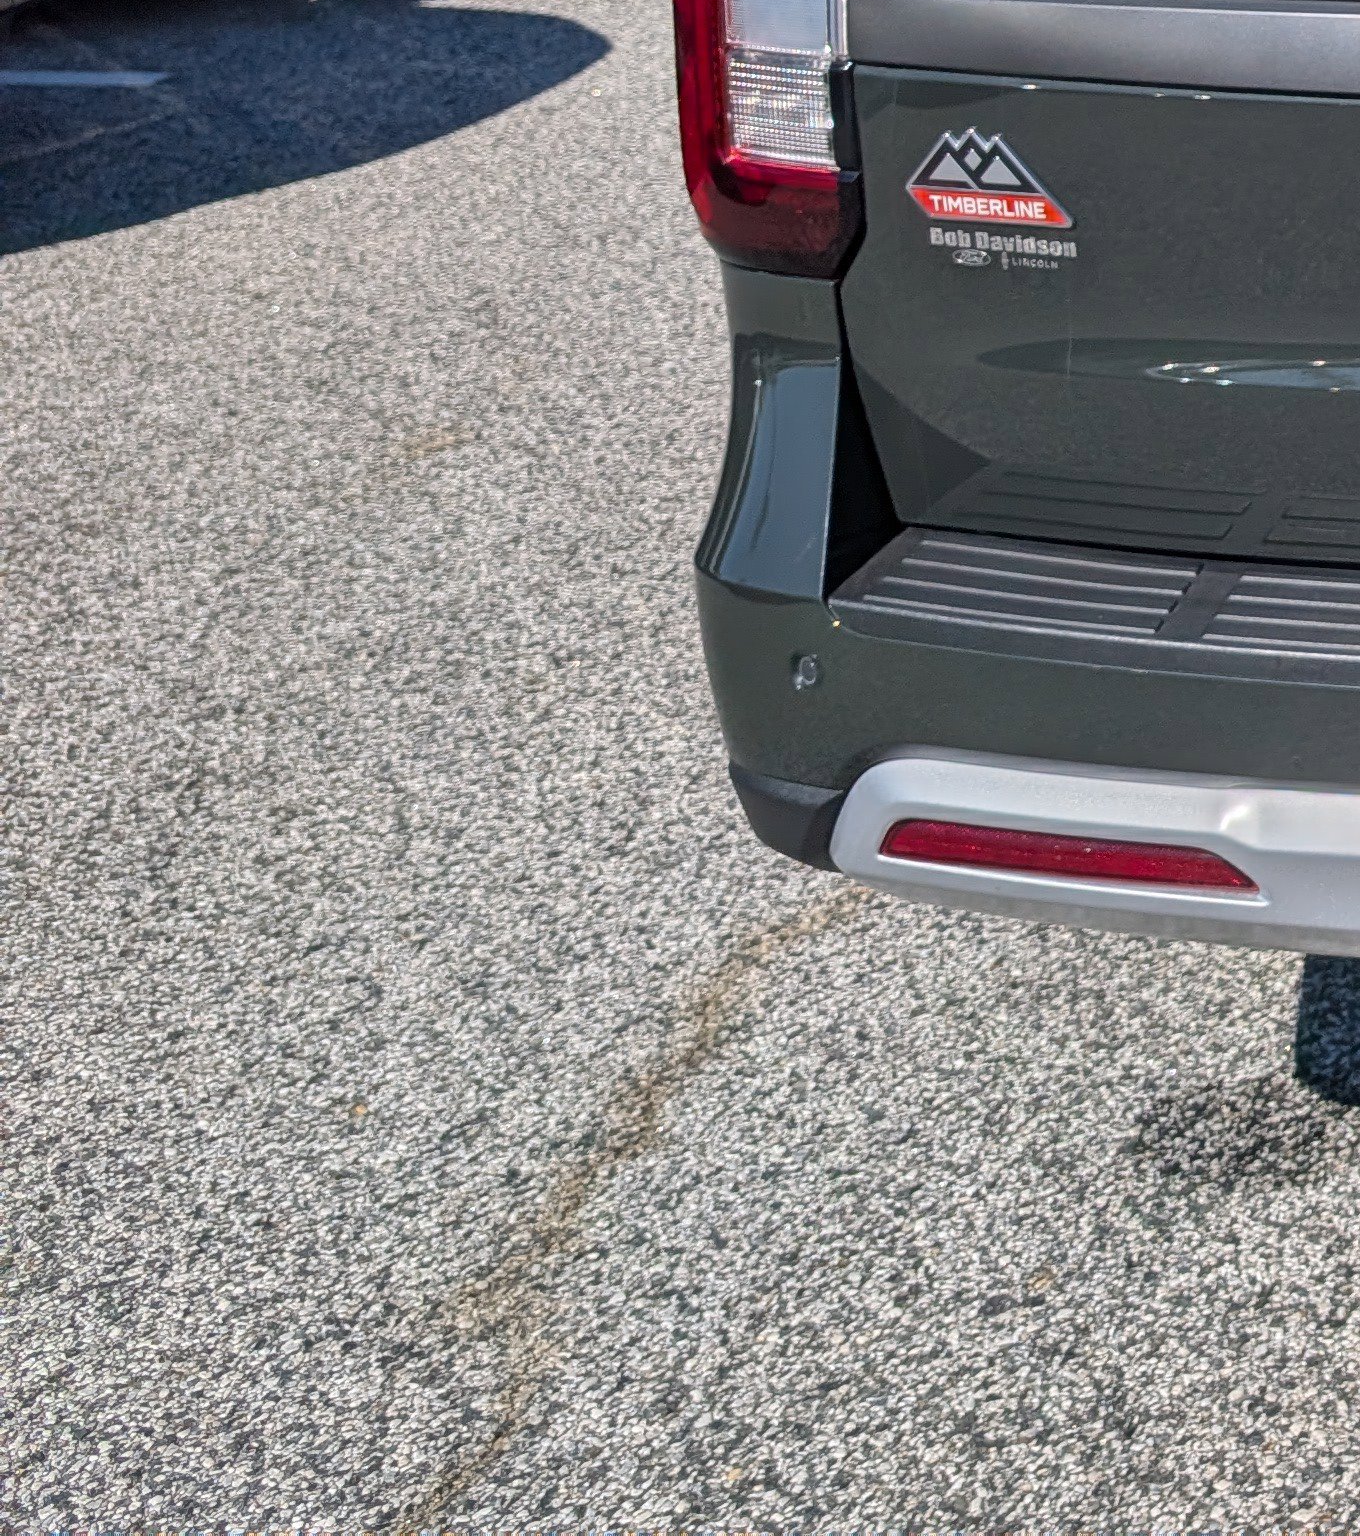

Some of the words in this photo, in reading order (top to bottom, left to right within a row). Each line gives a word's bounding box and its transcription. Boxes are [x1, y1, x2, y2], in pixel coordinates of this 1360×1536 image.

[928, 194, 1047, 219] TIMBERLINE
[930, 227, 971, 248] Bob
[975, 231, 1077, 258] Davidson
